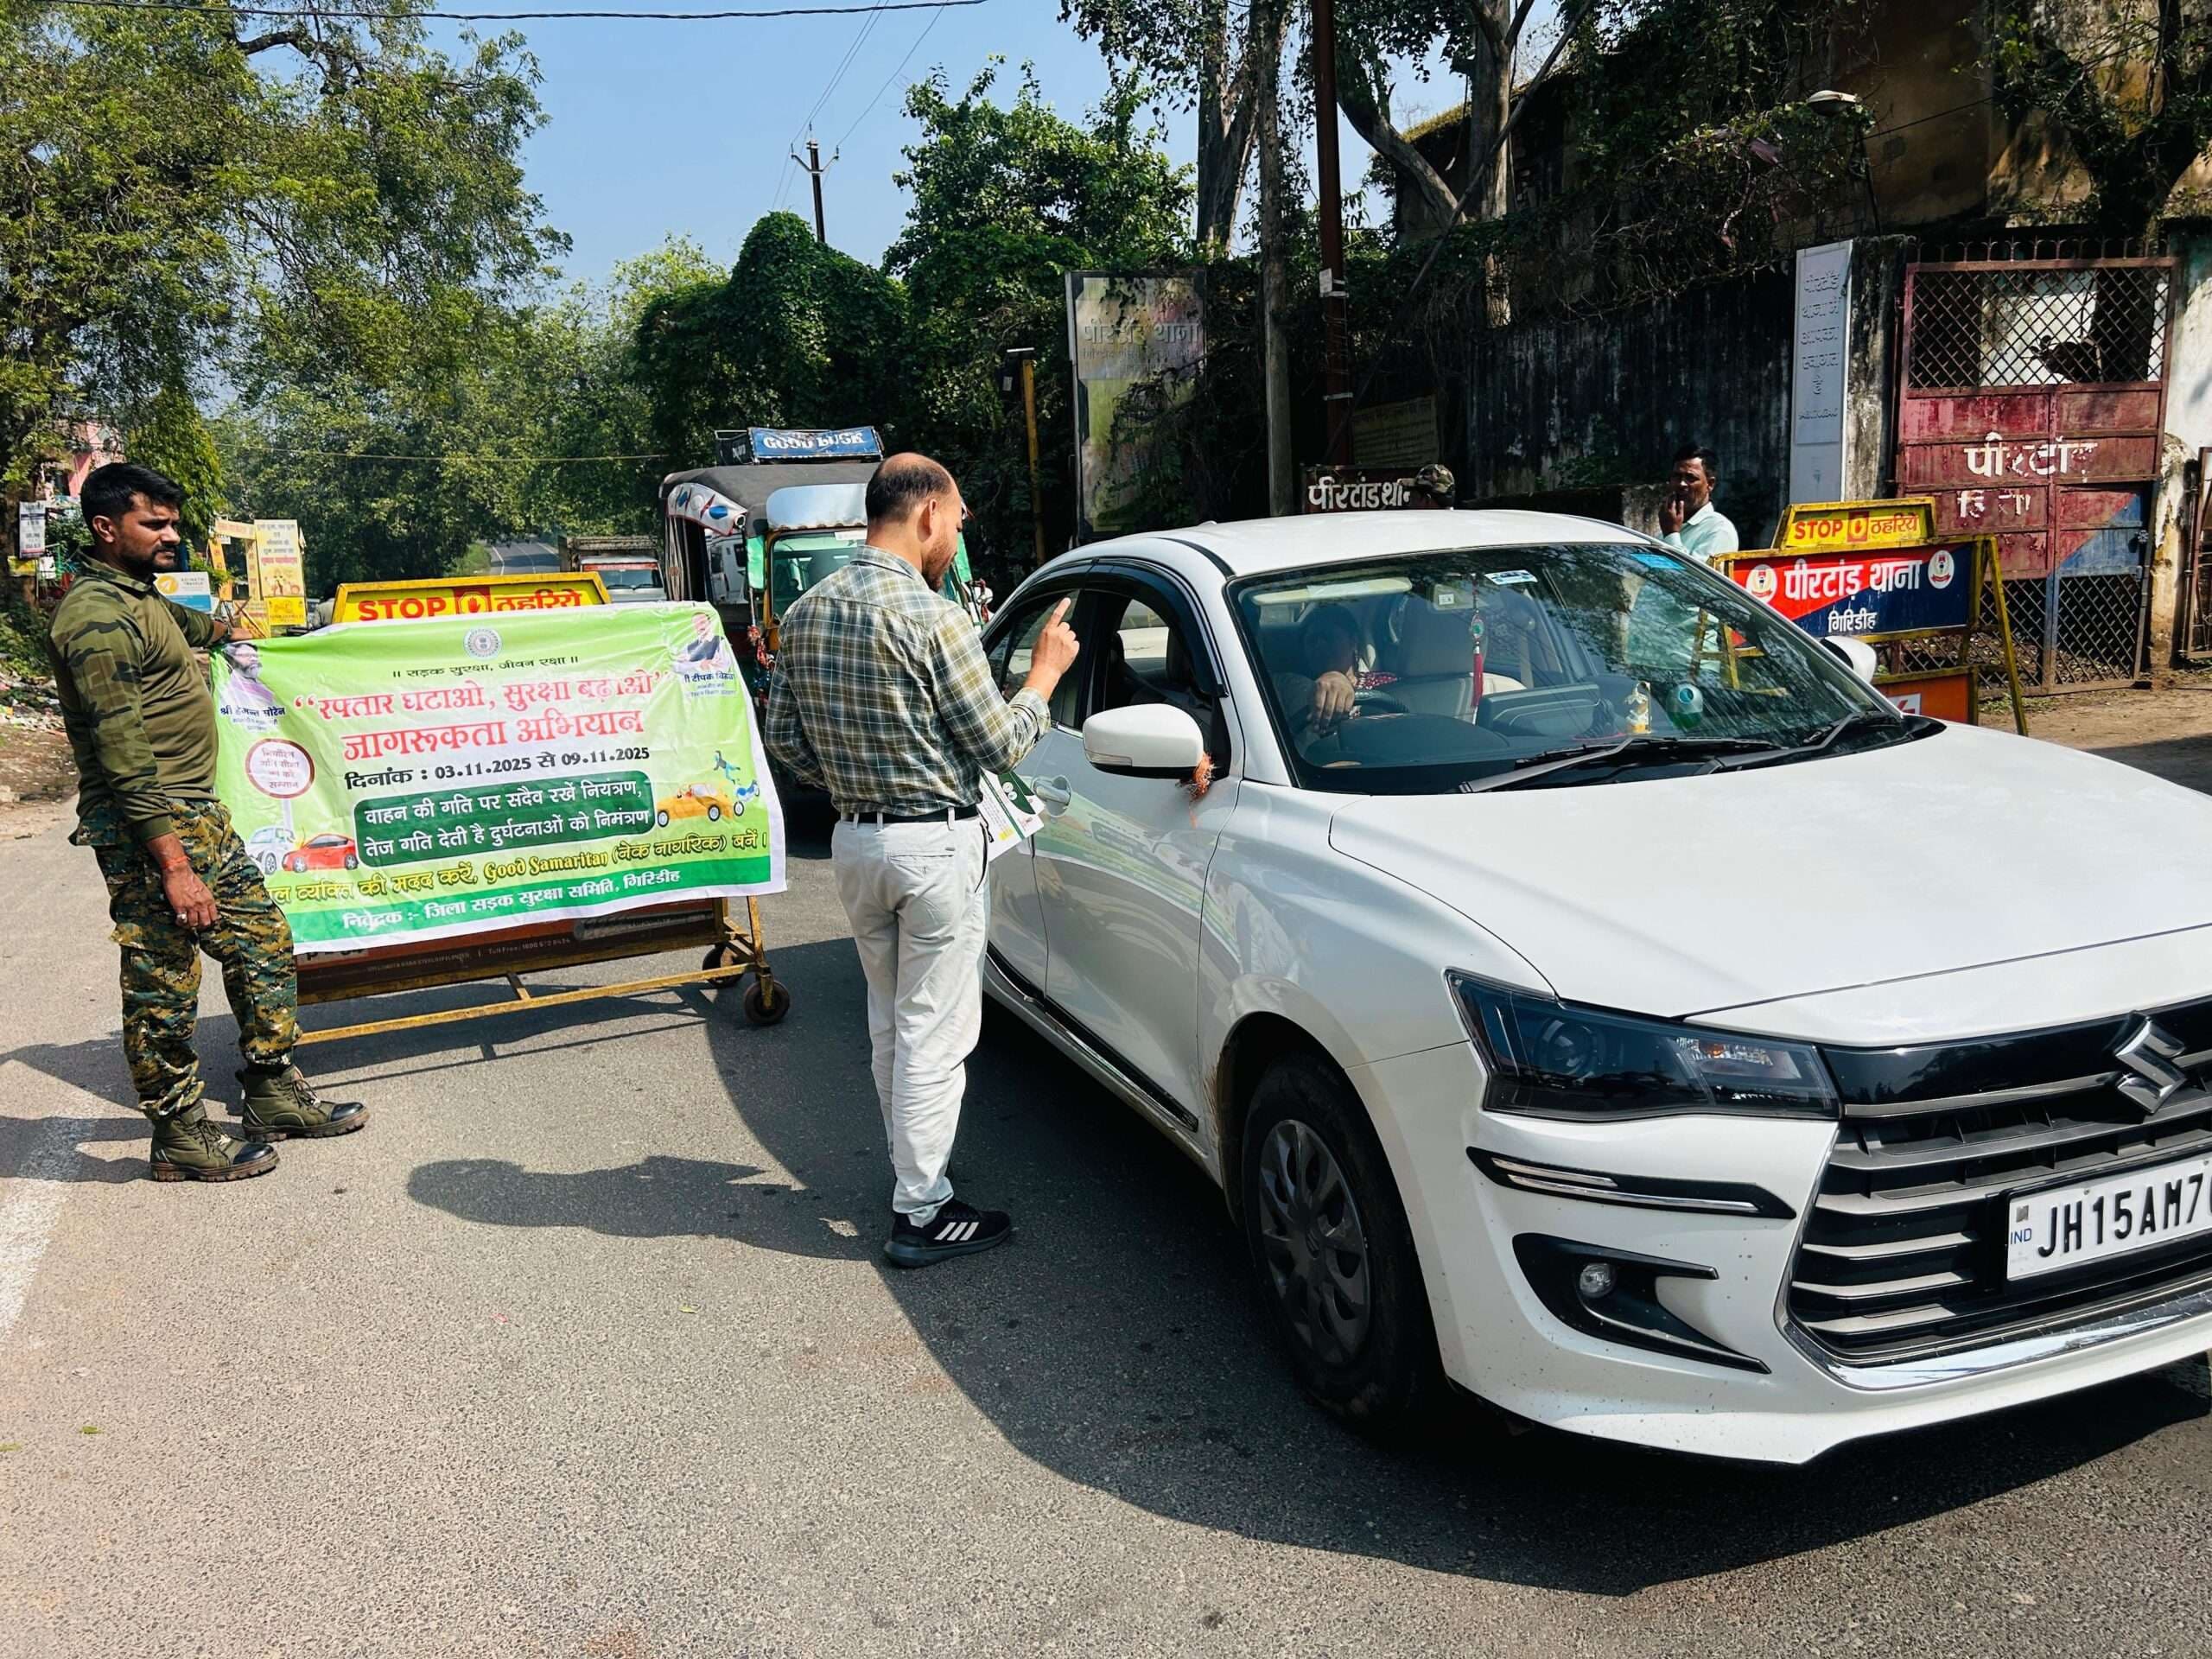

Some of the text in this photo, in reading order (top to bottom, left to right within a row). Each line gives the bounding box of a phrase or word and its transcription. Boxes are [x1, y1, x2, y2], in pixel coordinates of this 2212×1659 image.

[1795, 512, 1918, 540] STOP ठहरिये
[1783, 559, 1923, 601] पीरटांड़ थाना
[358, 596, 447, 621] STOP
[1827, 607, 1878, 632] गिरिडीह
[407, 668, 445, 678] सड़क
[449, 664, 493, 677] सुरक्षा,
[499, 659, 534, 669] जीवन
[539, 656, 566, 666] रक्षा
[401, 678, 496, 711] घटाओ,
[503, 682, 571, 711] सुरक्षा
[340, 707, 644, 760] जागरूकता अभियान
[344, 767, 413, 790] दिनांक
[435, 758, 531, 779] 03.11.2025
[537, 752, 556, 768] से
[561, 747, 650, 766] 09.11.2025
[365, 778, 642, 824] वाहन की गति पर सदैव रखें नियंत्रण,
[364, 807, 649, 857] तेज गति देती है दुर्घटनाओं को निमंत्रण
[358, 873, 387, 897] की
[391, 871, 434, 893] मदद
[438, 862, 478, 886] करें,
[484, 857, 526, 884] Good
[529, 850, 608, 874] Samaritan
[612, 841, 650, 864] (नेक
[654, 832, 727, 857] नागरिक)
[732, 829, 758, 849] बनें
[424, 899, 467, 920] जिला
[519, 887, 563, 906] सुरक्षा
[624, 868, 681, 889] गिरिडीह
[2011, 1228, 2032, 1244] IND
[2037, 1173, 2212, 1258] JH15AM7
